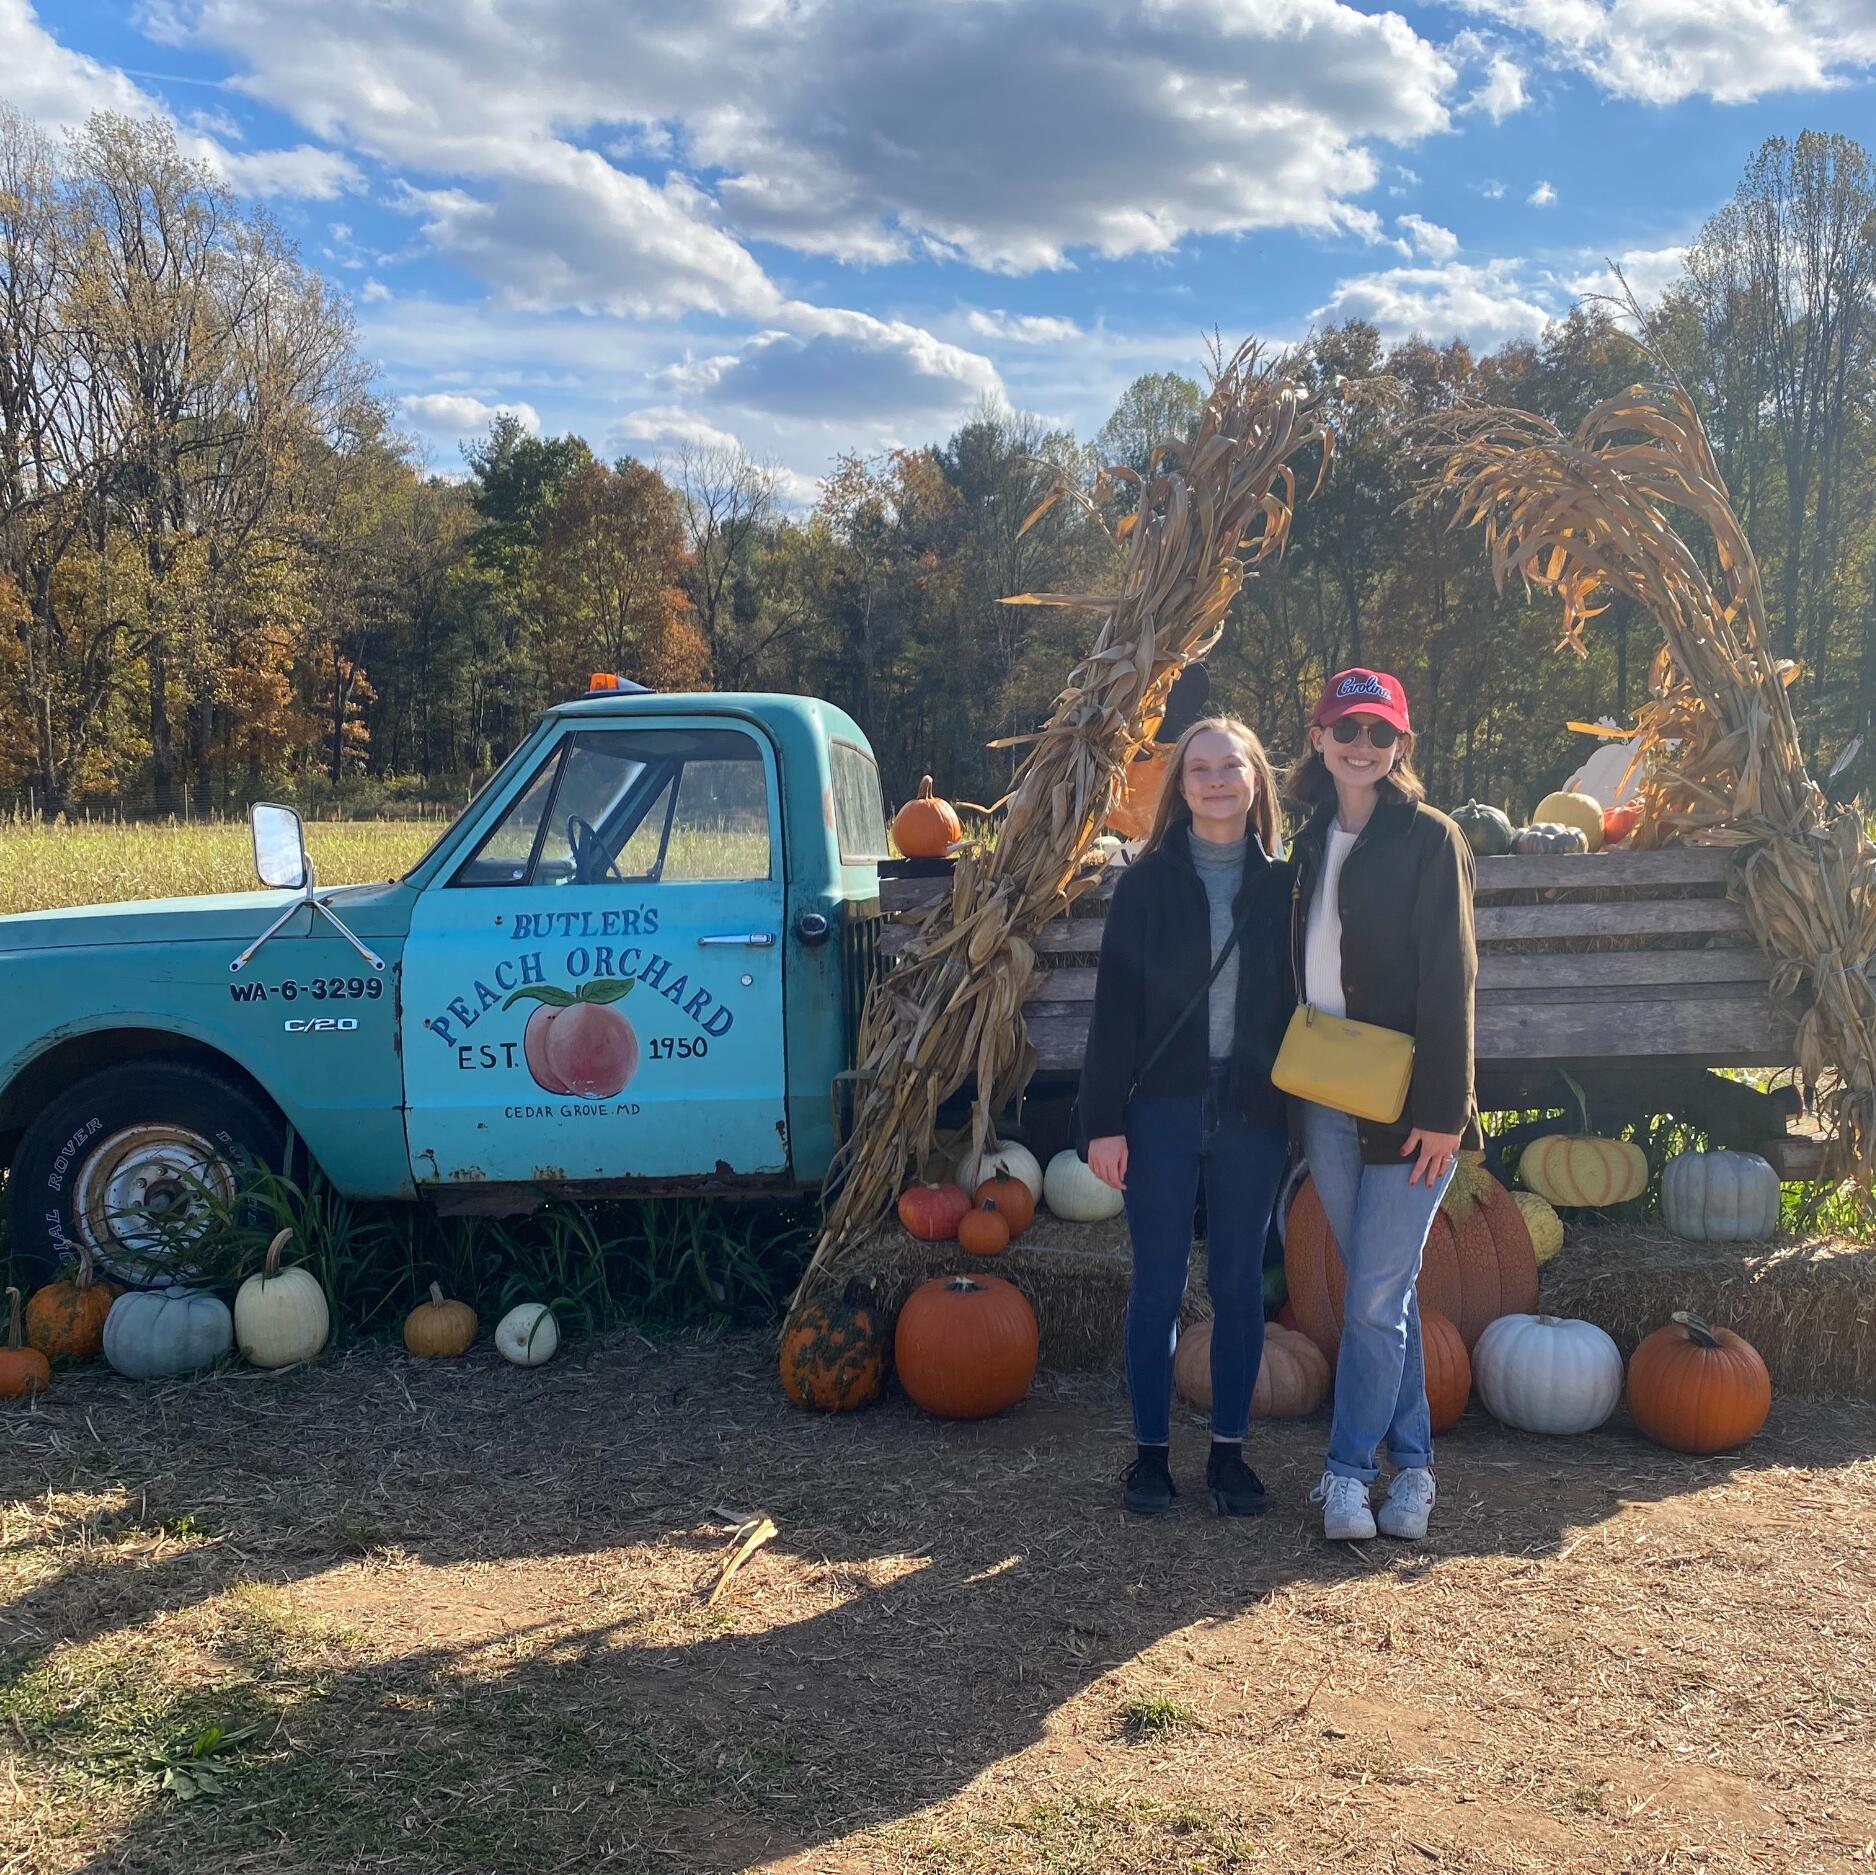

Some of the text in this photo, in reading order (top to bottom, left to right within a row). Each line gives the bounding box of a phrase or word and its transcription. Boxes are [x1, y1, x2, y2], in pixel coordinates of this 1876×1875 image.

[510, 904, 659, 940] BUTLER'S
[230, 978, 383, 1001] WA-6-3299
[430, 946, 735, 1048] PEACH ORCHARD
[284, 1018, 359, 1032] C/20
[458, 1036, 708, 1070] EST. 1950
[505, 1106, 554, 1119] CEDAR
[48, 1117, 103, 1191] ROVER
